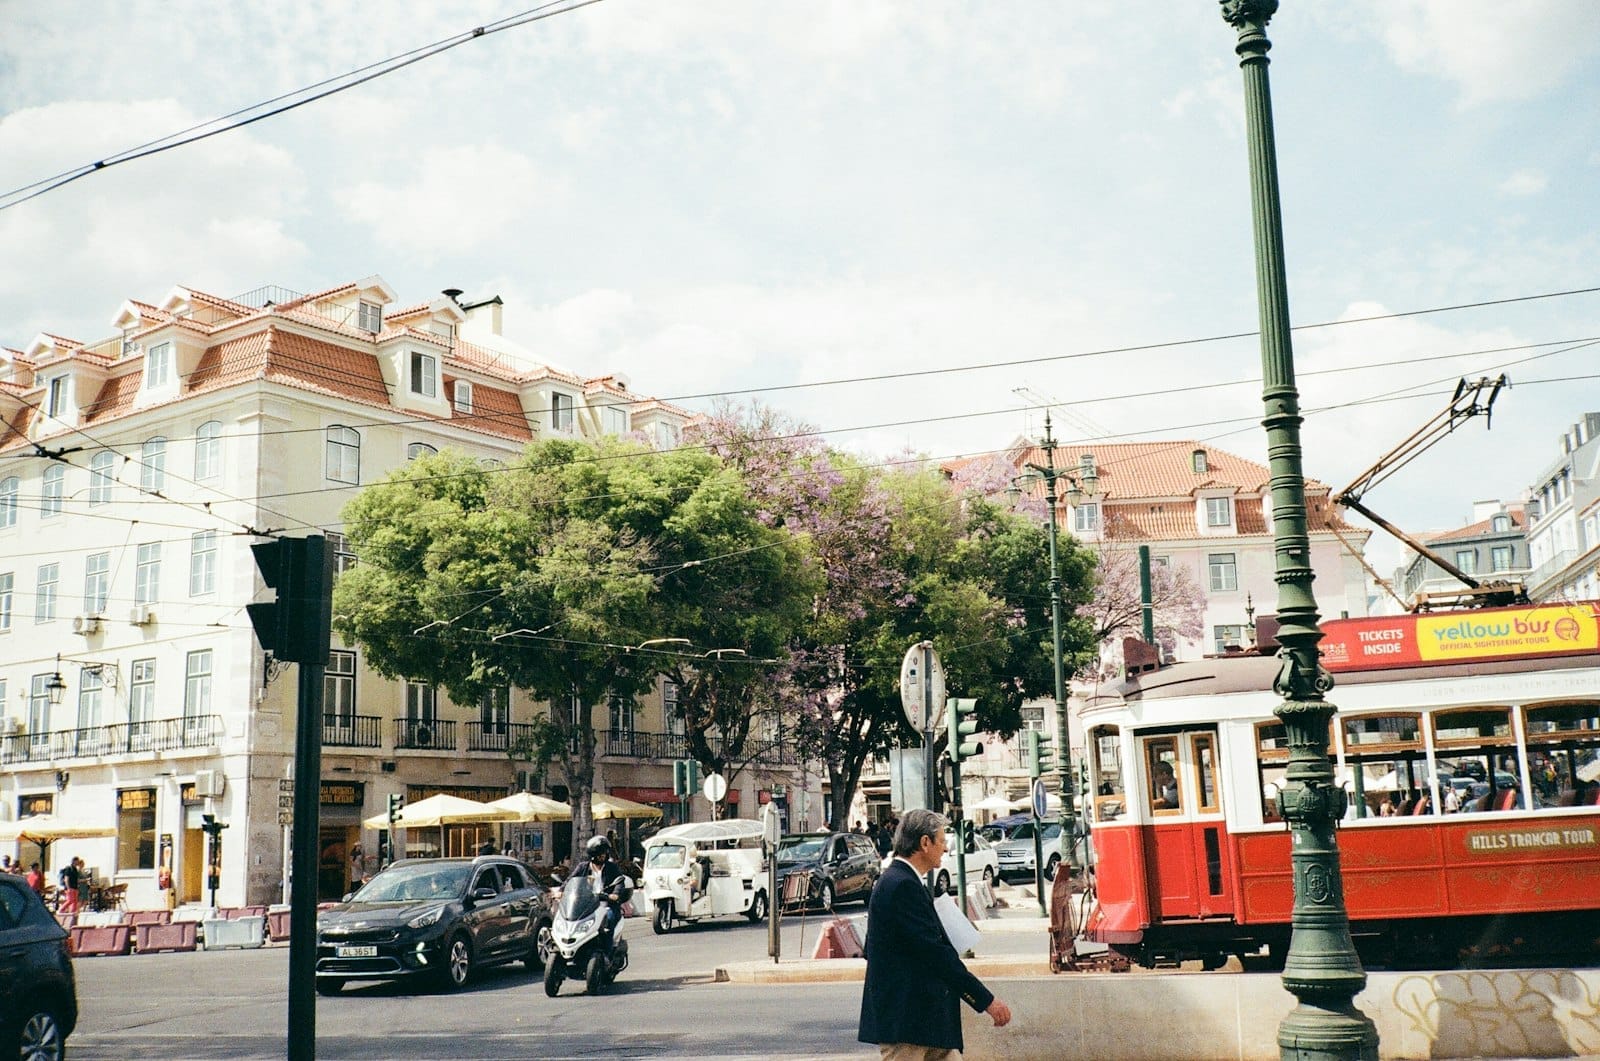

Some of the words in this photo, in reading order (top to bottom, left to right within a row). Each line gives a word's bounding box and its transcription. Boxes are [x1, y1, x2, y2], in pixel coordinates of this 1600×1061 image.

[1358, 629, 1404, 642] TICKETS
[1433, 621, 1510, 641] yellow
[1513, 617, 1551, 635] bus
[1364, 643, 1402, 655] INSIDE
[1440, 642, 1472, 651] OFFICIAL
[1474, 639, 1523, 649] SIGHTSEEING
[1525, 636, 1550, 645] TOURS
[1472, 834, 1508, 849] HILLS
[1563, 829, 1595, 845] TOUR
